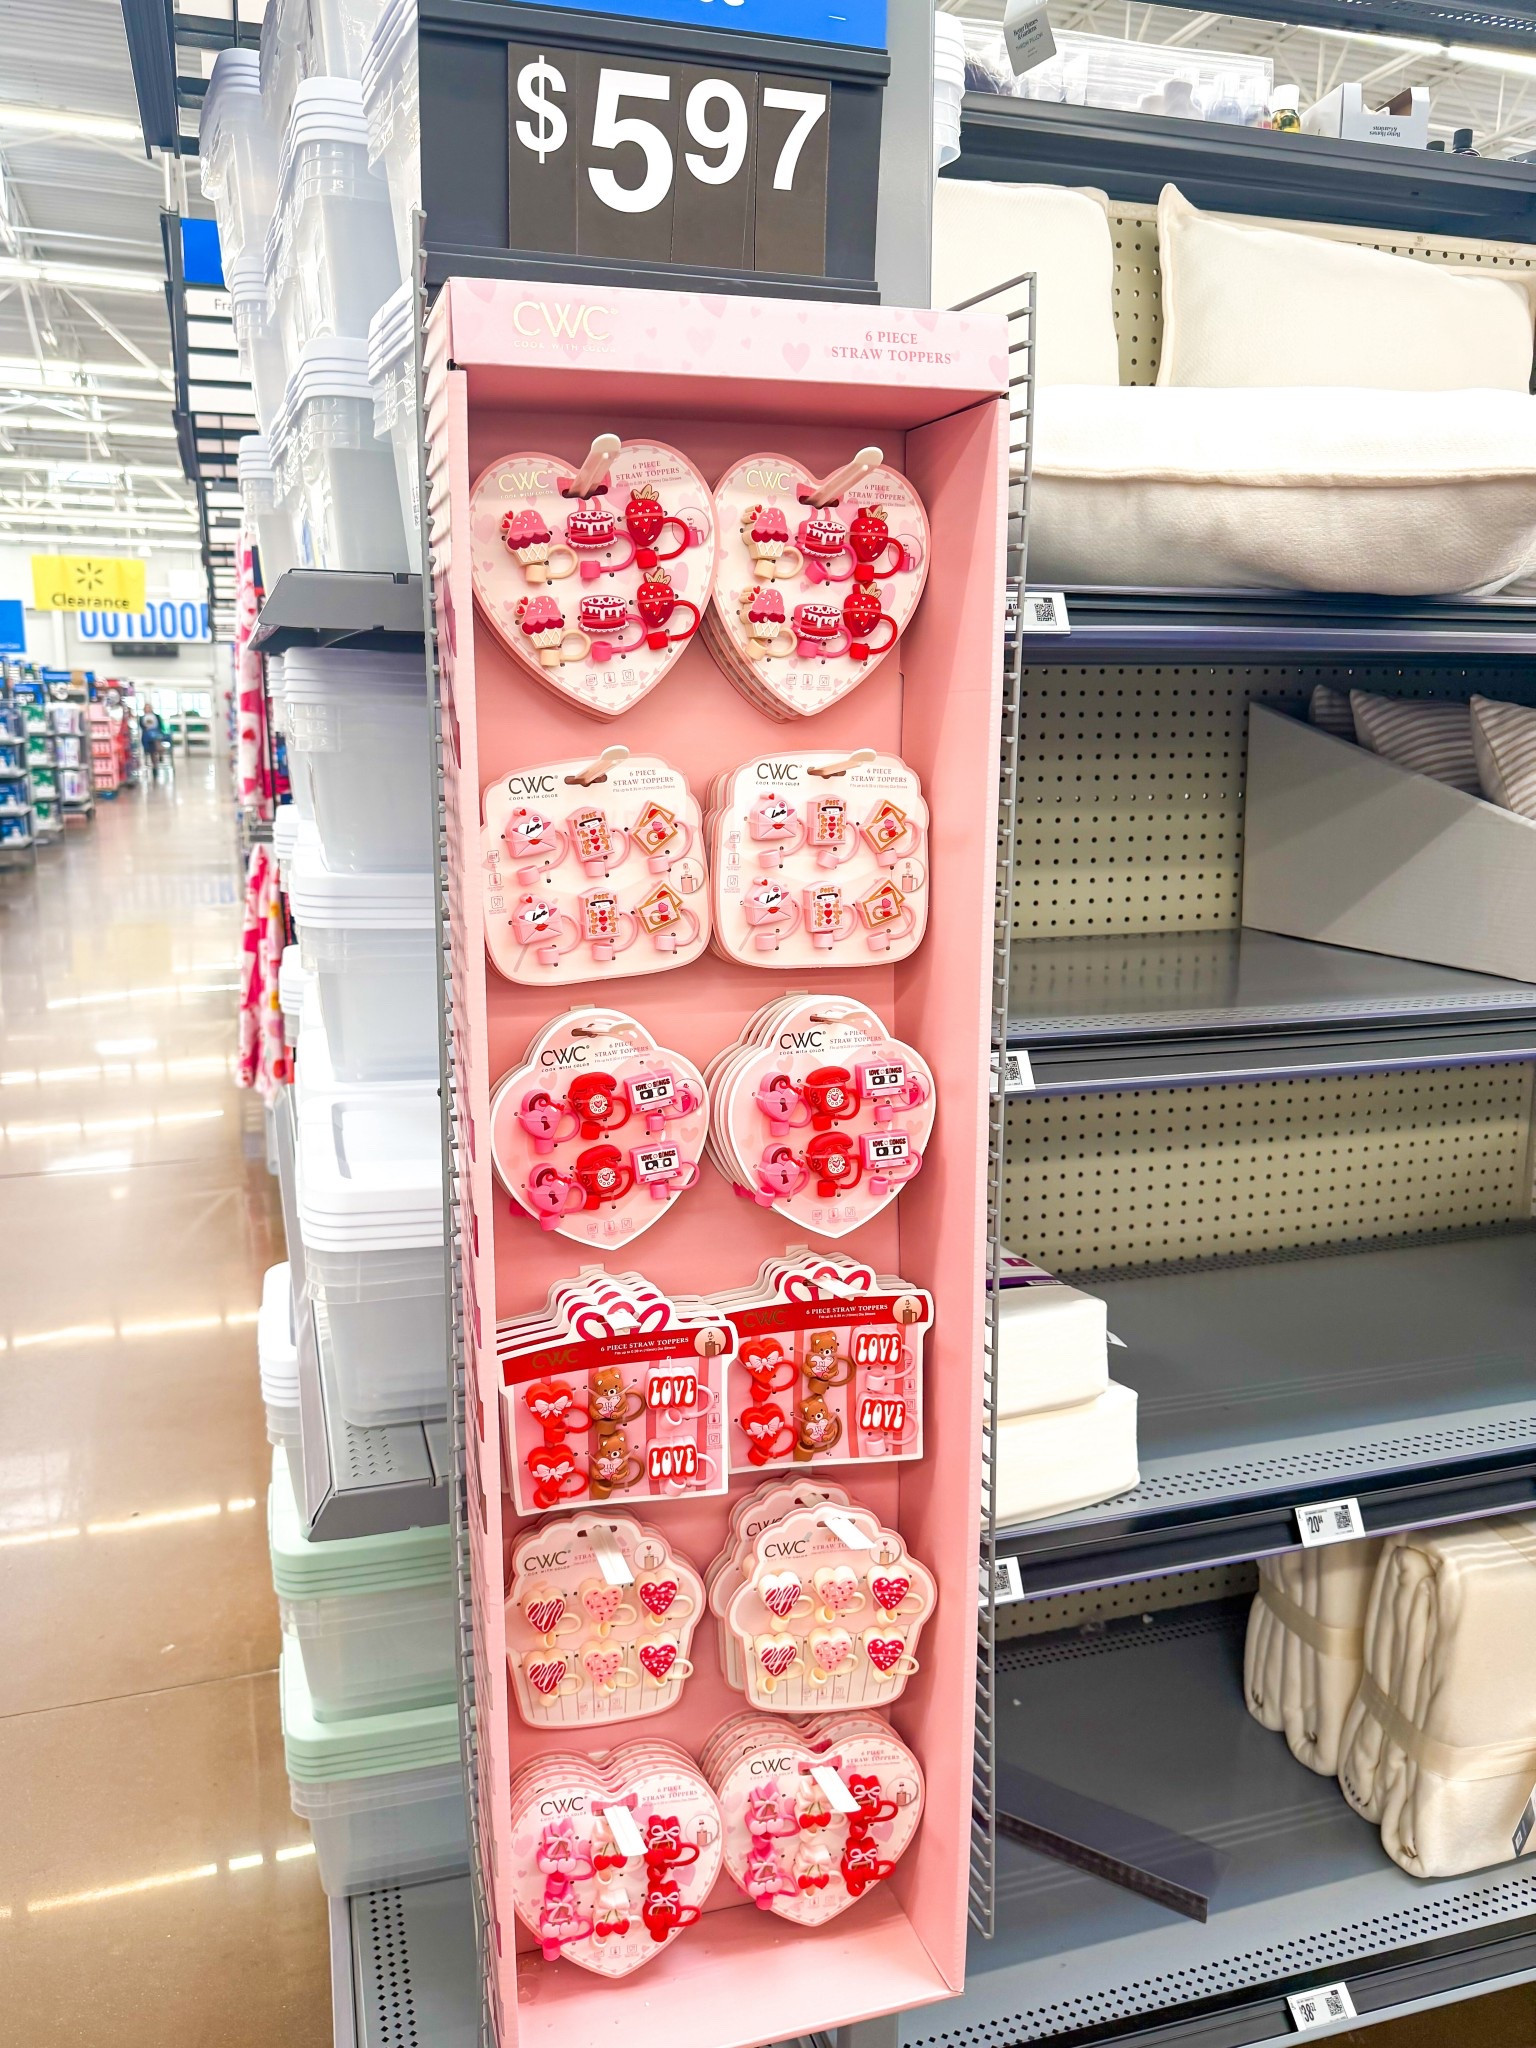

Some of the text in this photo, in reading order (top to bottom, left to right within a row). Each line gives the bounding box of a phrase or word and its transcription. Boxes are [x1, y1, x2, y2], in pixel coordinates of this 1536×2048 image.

[513, 300, 610, 341] CWC
[514, 340, 545, 349] COOK
[552, 342, 578, 352] WITH
[866, 330, 918, 344] 6 PIECE
[832, 346, 951, 364] STRAW TOPPERS
[639, 460, 660, 468] PIECE
[498, 470, 549, 492] CWC
[616, 467, 680, 480] STRAW TOPPERS
[746, 470, 790, 490] CWC
[875, 492, 906, 500] TOPPERS
[52, 593, 130, 610] Clearance
[640, 776, 674, 784] TOPPERS
[756, 762, 798, 780] CWC
[508, 776, 554, 794] CWC
[770, 808, 786, 818] Love
[526, 823, 542, 834] Love
[766, 893, 780, 904] Love
[532, 910, 548, 922] Love
[620, 1046, 649, 1054] TOPPERS
[780, 1032, 822, 1050] CWC
[540, 1046, 586, 1066] CWC
[652, 1078, 670, 1088] SONGS
[641, 1150, 676, 1162] LOVE SONGS
[743, 1309, 787, 1328] CWC
[606, 1344, 628, 1352] PIECE
[630, 1340, 655, 1348] STRAW
[657, 1337, 688, 1346] TOPPERS
[858, 1334, 899, 1363] LOVE
[532, 1348, 578, 1368] CWC
[652, 1376, 695, 1406] LOVE
[862, 1400, 904, 1428] LOVE
[652, 1446, 695, 1476] LOVE
[764, 1540, 806, 1558] CWC
[524, 1550, 568, 1572] CWC
[750, 1758, 791, 1775] CWC
[540, 1796, 584, 1816] CWC
